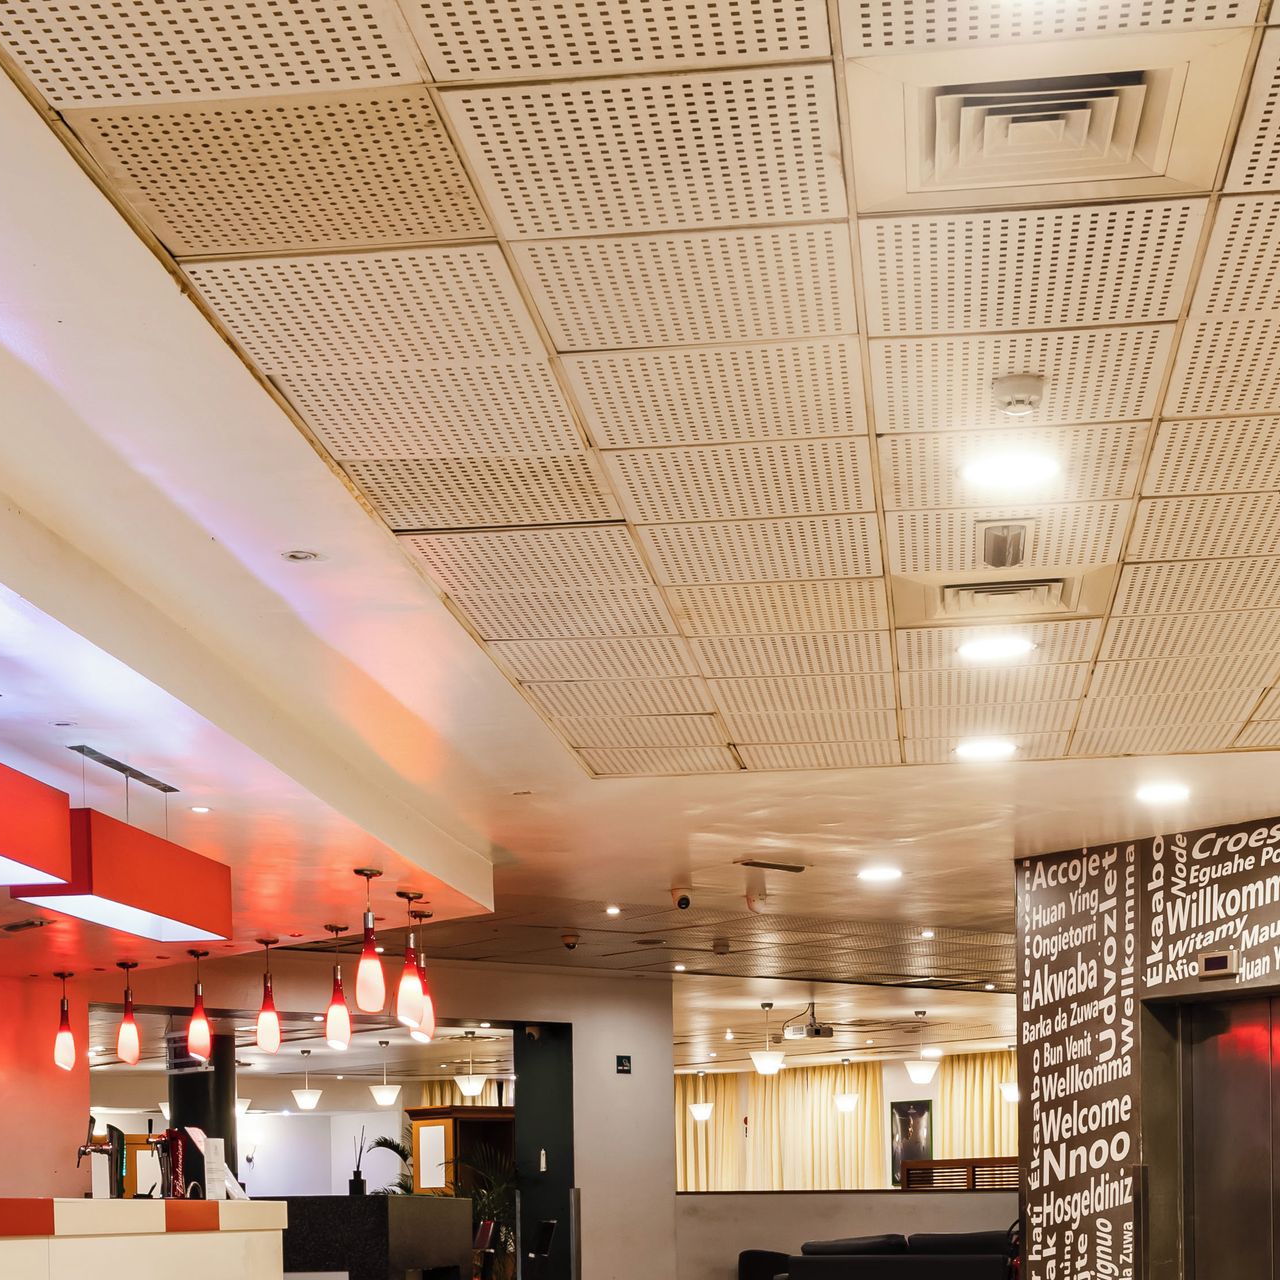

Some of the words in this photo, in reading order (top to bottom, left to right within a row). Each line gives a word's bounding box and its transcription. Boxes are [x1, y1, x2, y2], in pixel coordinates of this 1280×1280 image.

[1032, 848, 1101, 892] Accoje
[1171, 833, 1187, 897] Node
[1189, 857, 1255, 887] Eguahe
[1032, 900, 1066, 931] Huan
[1069, 887, 1099, 917] Ying
[1032, 916, 1097, 962] Ongietorri
[1120, 844, 1135, 1055] Wellkomma
[1169, 914, 1249, 961] Witamy
[1030, 951, 1098, 1010] Akwaba
[1165, 959, 1199, 983] Afio
[1022, 1016, 1052, 1045] Barka
[1054, 1010, 1068, 1034] da
[1070, 1000, 1100, 1027] Zuwa
[1043, 1042, 1063, 1068] Bun
[1065, 1030, 1092, 1062] Venit
[1041, 1054, 1132, 1103] Wellkomma
[1041, 1094, 1132, 1145] Welcome
[1043, 1131, 1130, 1187] Nnoo
[1043, 1168, 1133, 1231] Hosgeldiniz
[1119, 1222, 1133, 1263] Zuwa
